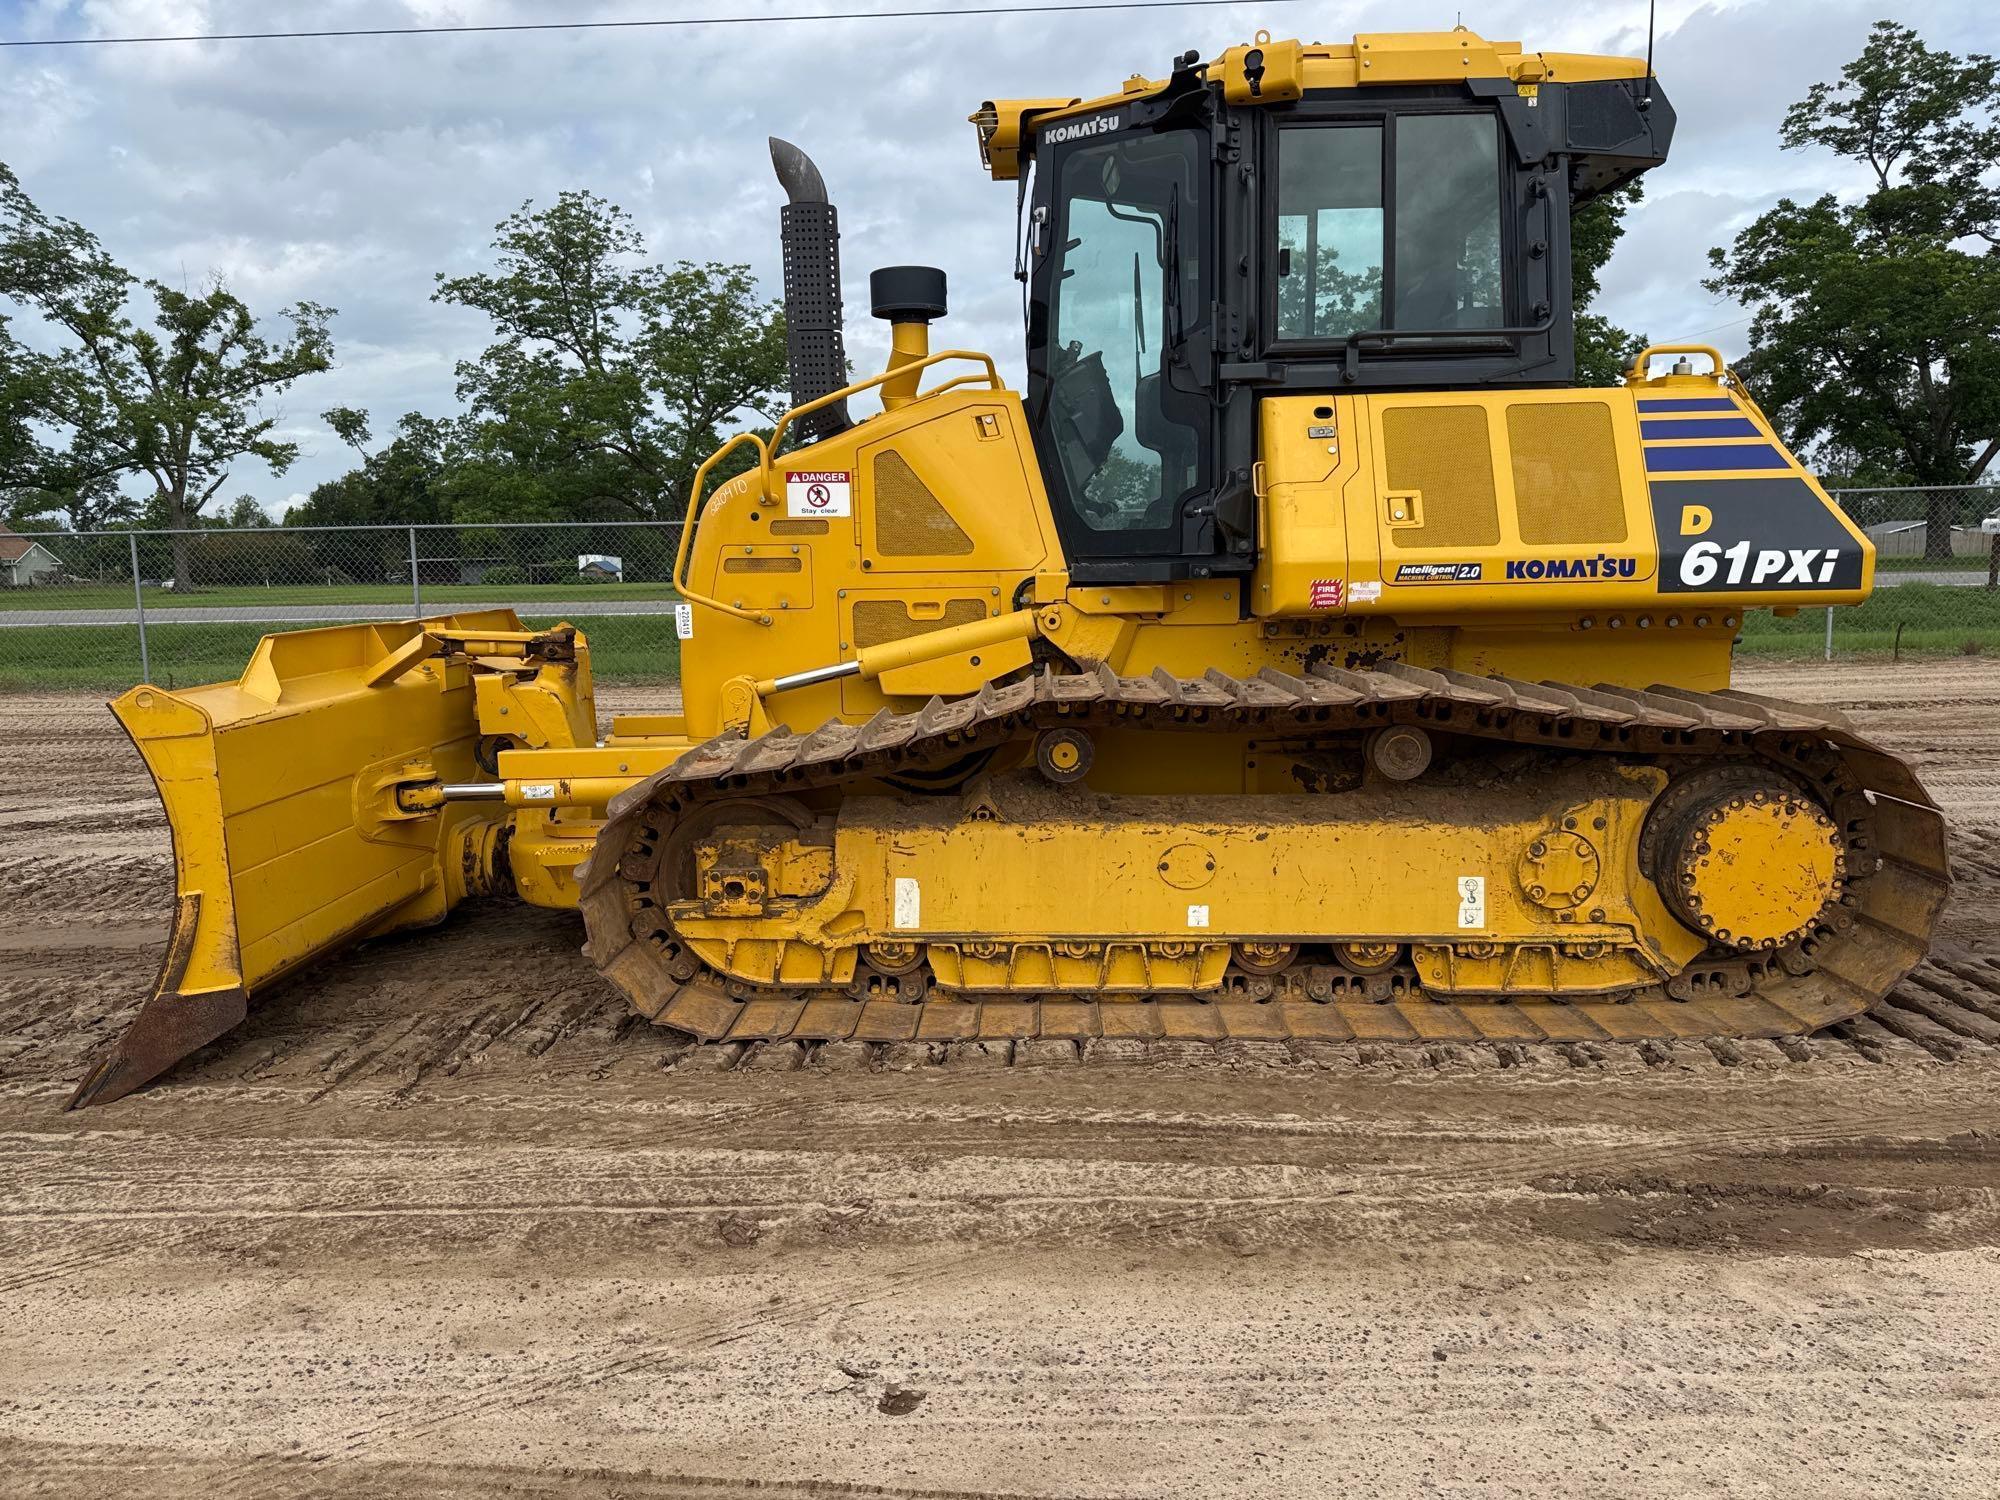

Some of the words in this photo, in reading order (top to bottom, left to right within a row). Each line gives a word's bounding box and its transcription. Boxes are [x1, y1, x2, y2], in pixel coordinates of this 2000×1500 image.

[1045, 116, 1119, 145] KOMATSU
[802, 473, 846, 482] DANGER
[1679, 505, 1713, 536] D
[1459, 566, 1480, 578] 2.0
[1506, 554, 1636, 579] KOMATSU
[1317, 585, 1337, 593] FIRE
